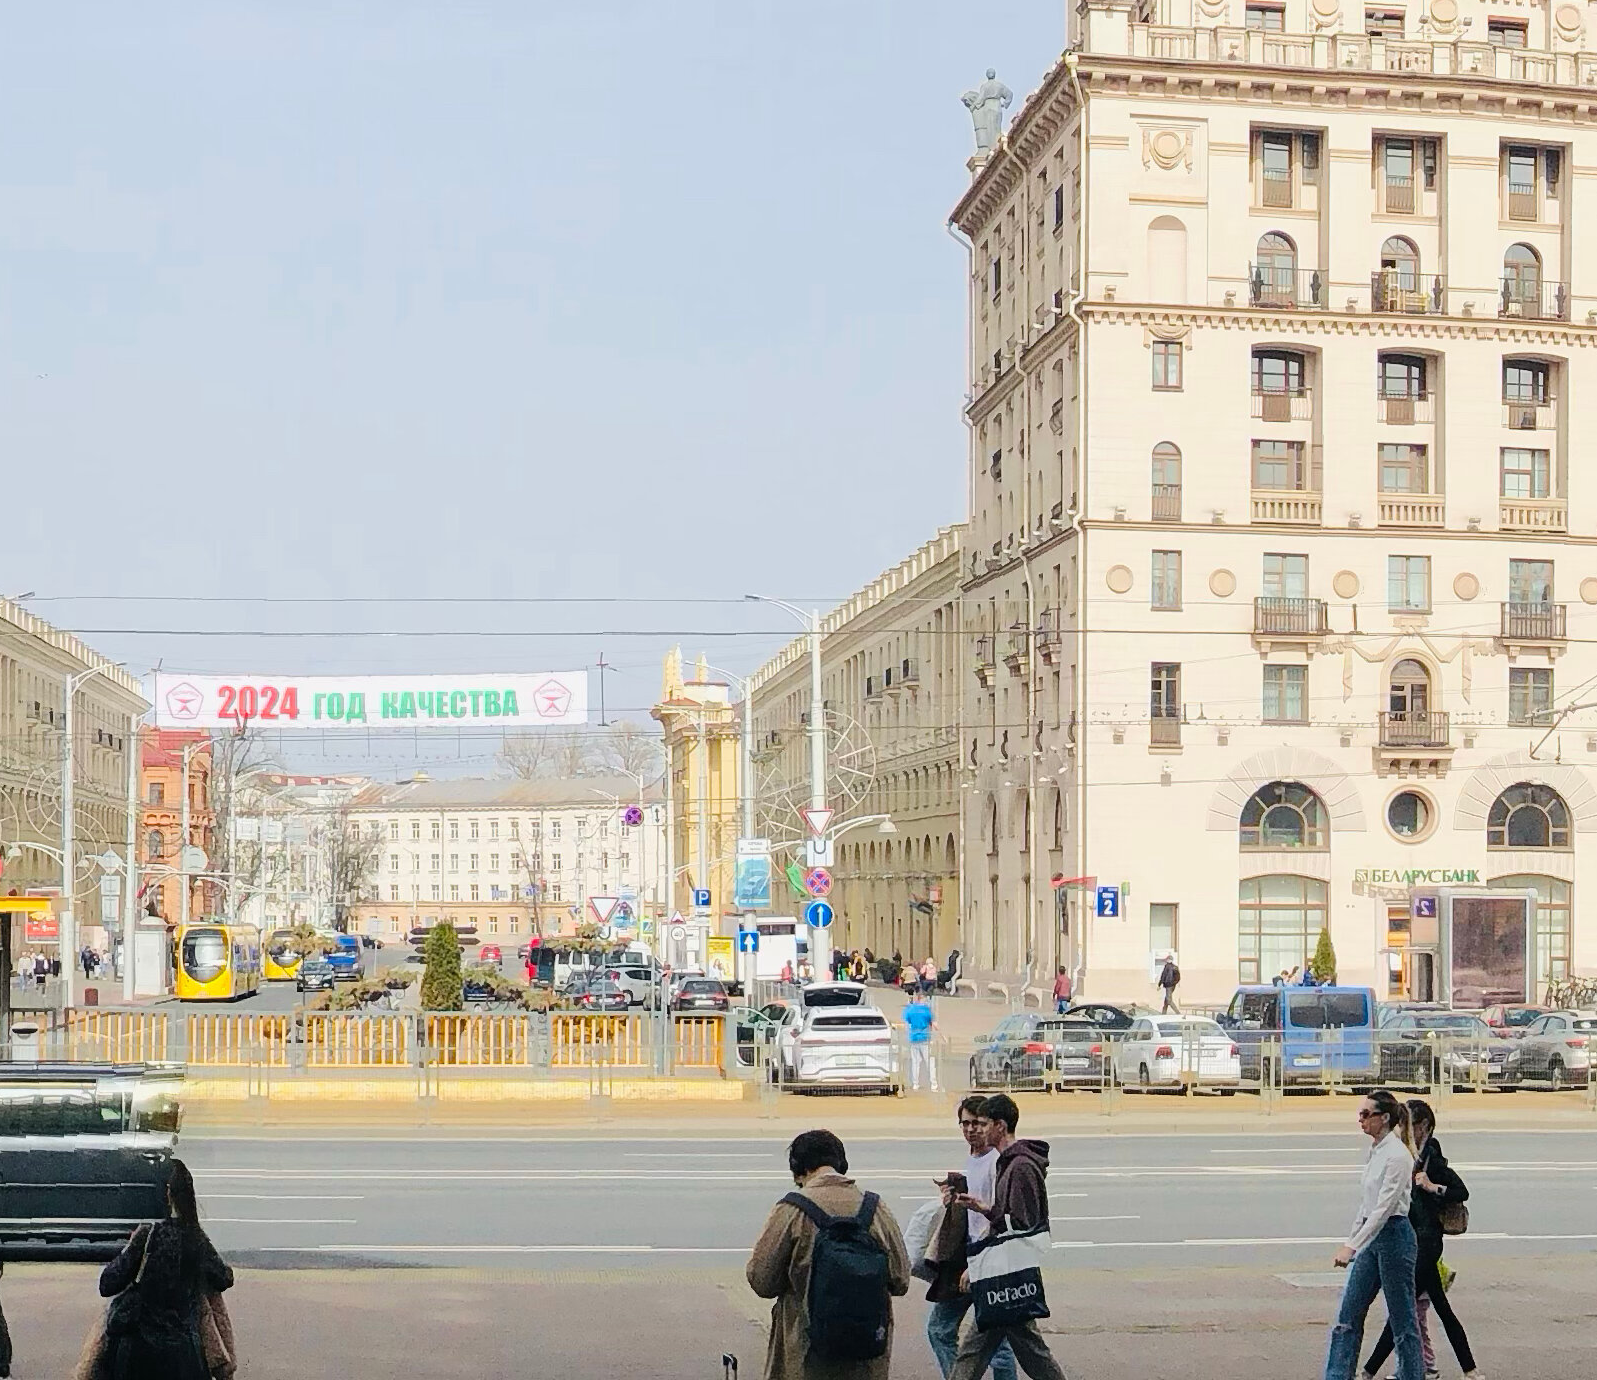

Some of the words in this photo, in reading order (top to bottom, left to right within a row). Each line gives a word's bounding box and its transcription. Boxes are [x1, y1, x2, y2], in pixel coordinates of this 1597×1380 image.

[218, 684, 299, 719] 2024
[314, 691, 368, 723] ГОД
[381, 689, 520, 719] КАЧЕСТВА
[1372, 869, 1480, 883] БЕЛАРУСБАНК
[698, 891, 710, 905] P
[1103, 900, 1114, 915] 2
[987, 1283, 1038, 1305] DeFacto
